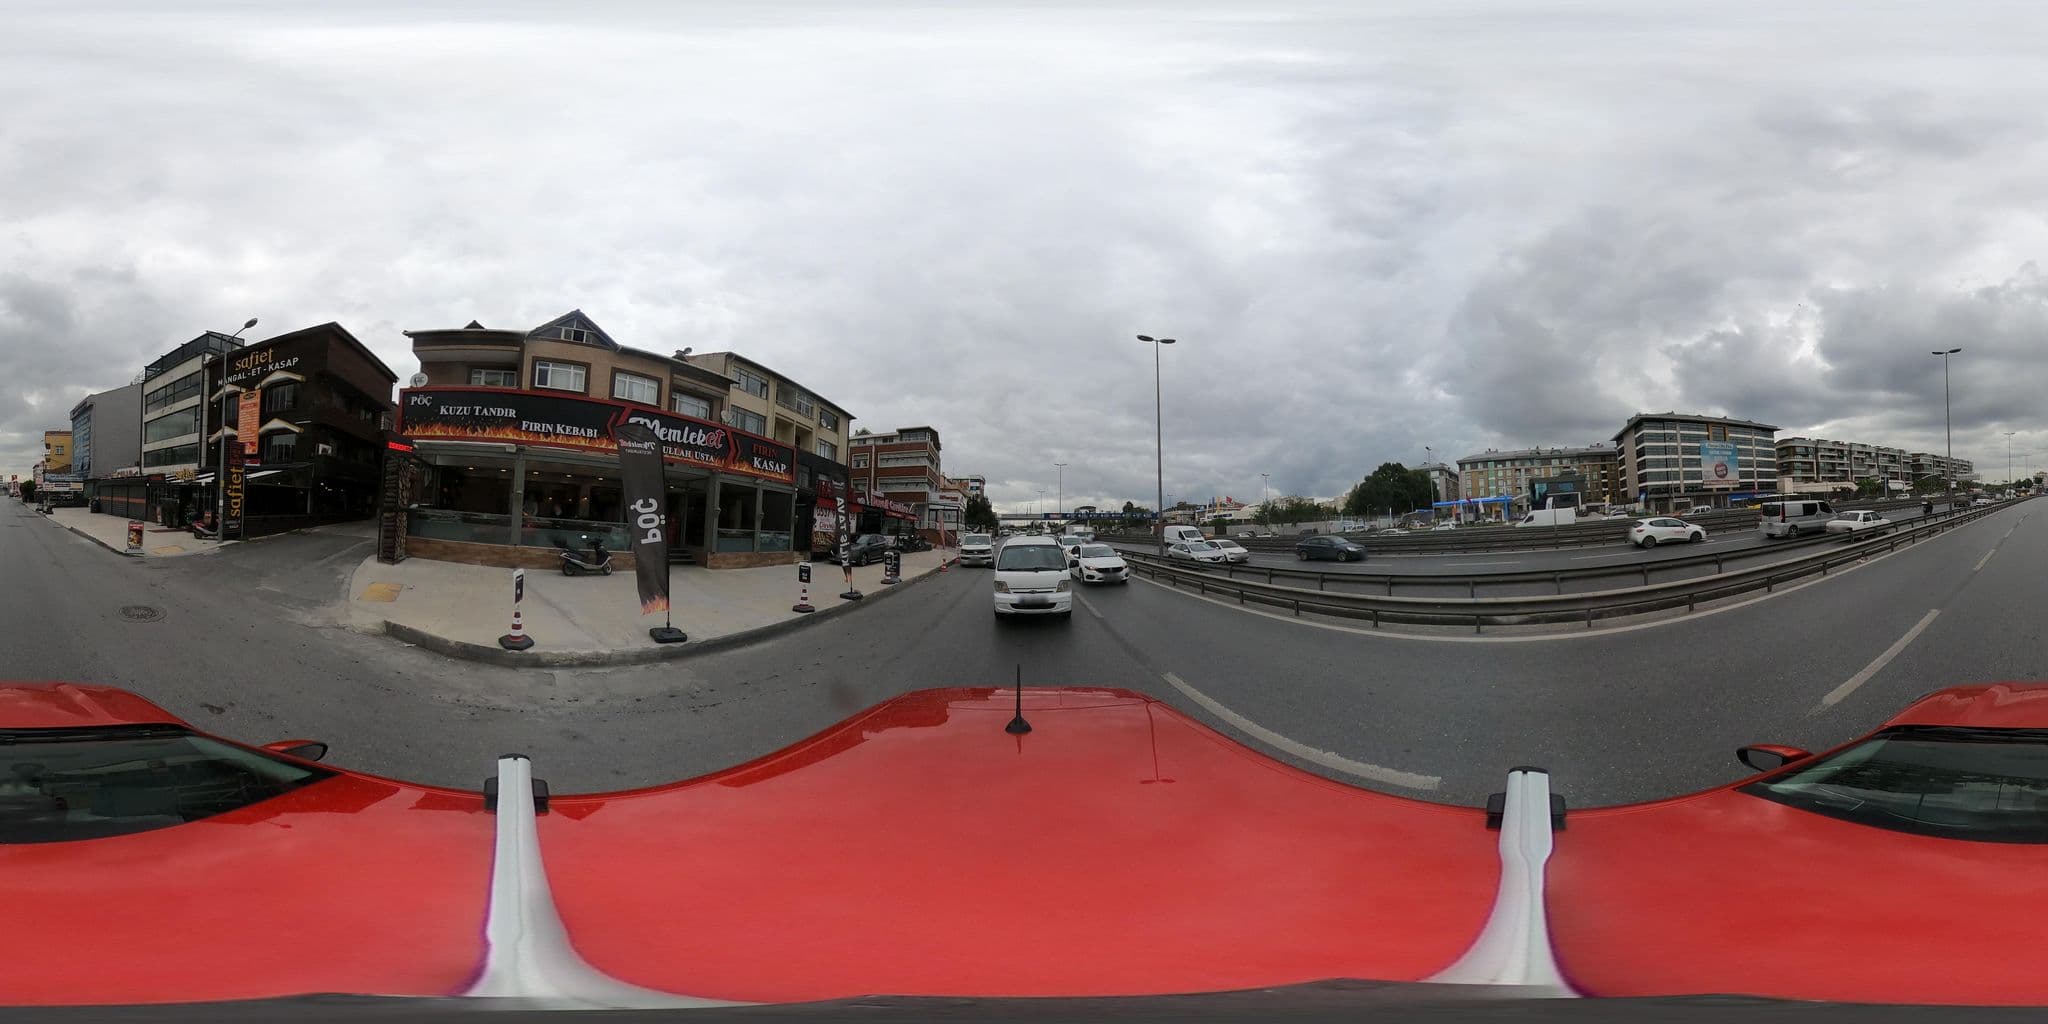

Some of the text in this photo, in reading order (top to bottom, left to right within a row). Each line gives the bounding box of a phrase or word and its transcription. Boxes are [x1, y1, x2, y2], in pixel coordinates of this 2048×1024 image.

[235, 347, 274, 371] safiet
[410, 394, 433, 407] PÖÇ
[440, 405, 516, 418] KUZU TANDIR
[522, 420, 598, 438] FIRIN KEBABI
[662, 446, 714, 462] ULLAH USTA
[752, 444, 778, 458] FIRIN
[753, 456, 786, 473] KASAP
[227, 465, 244, 518] safiet
